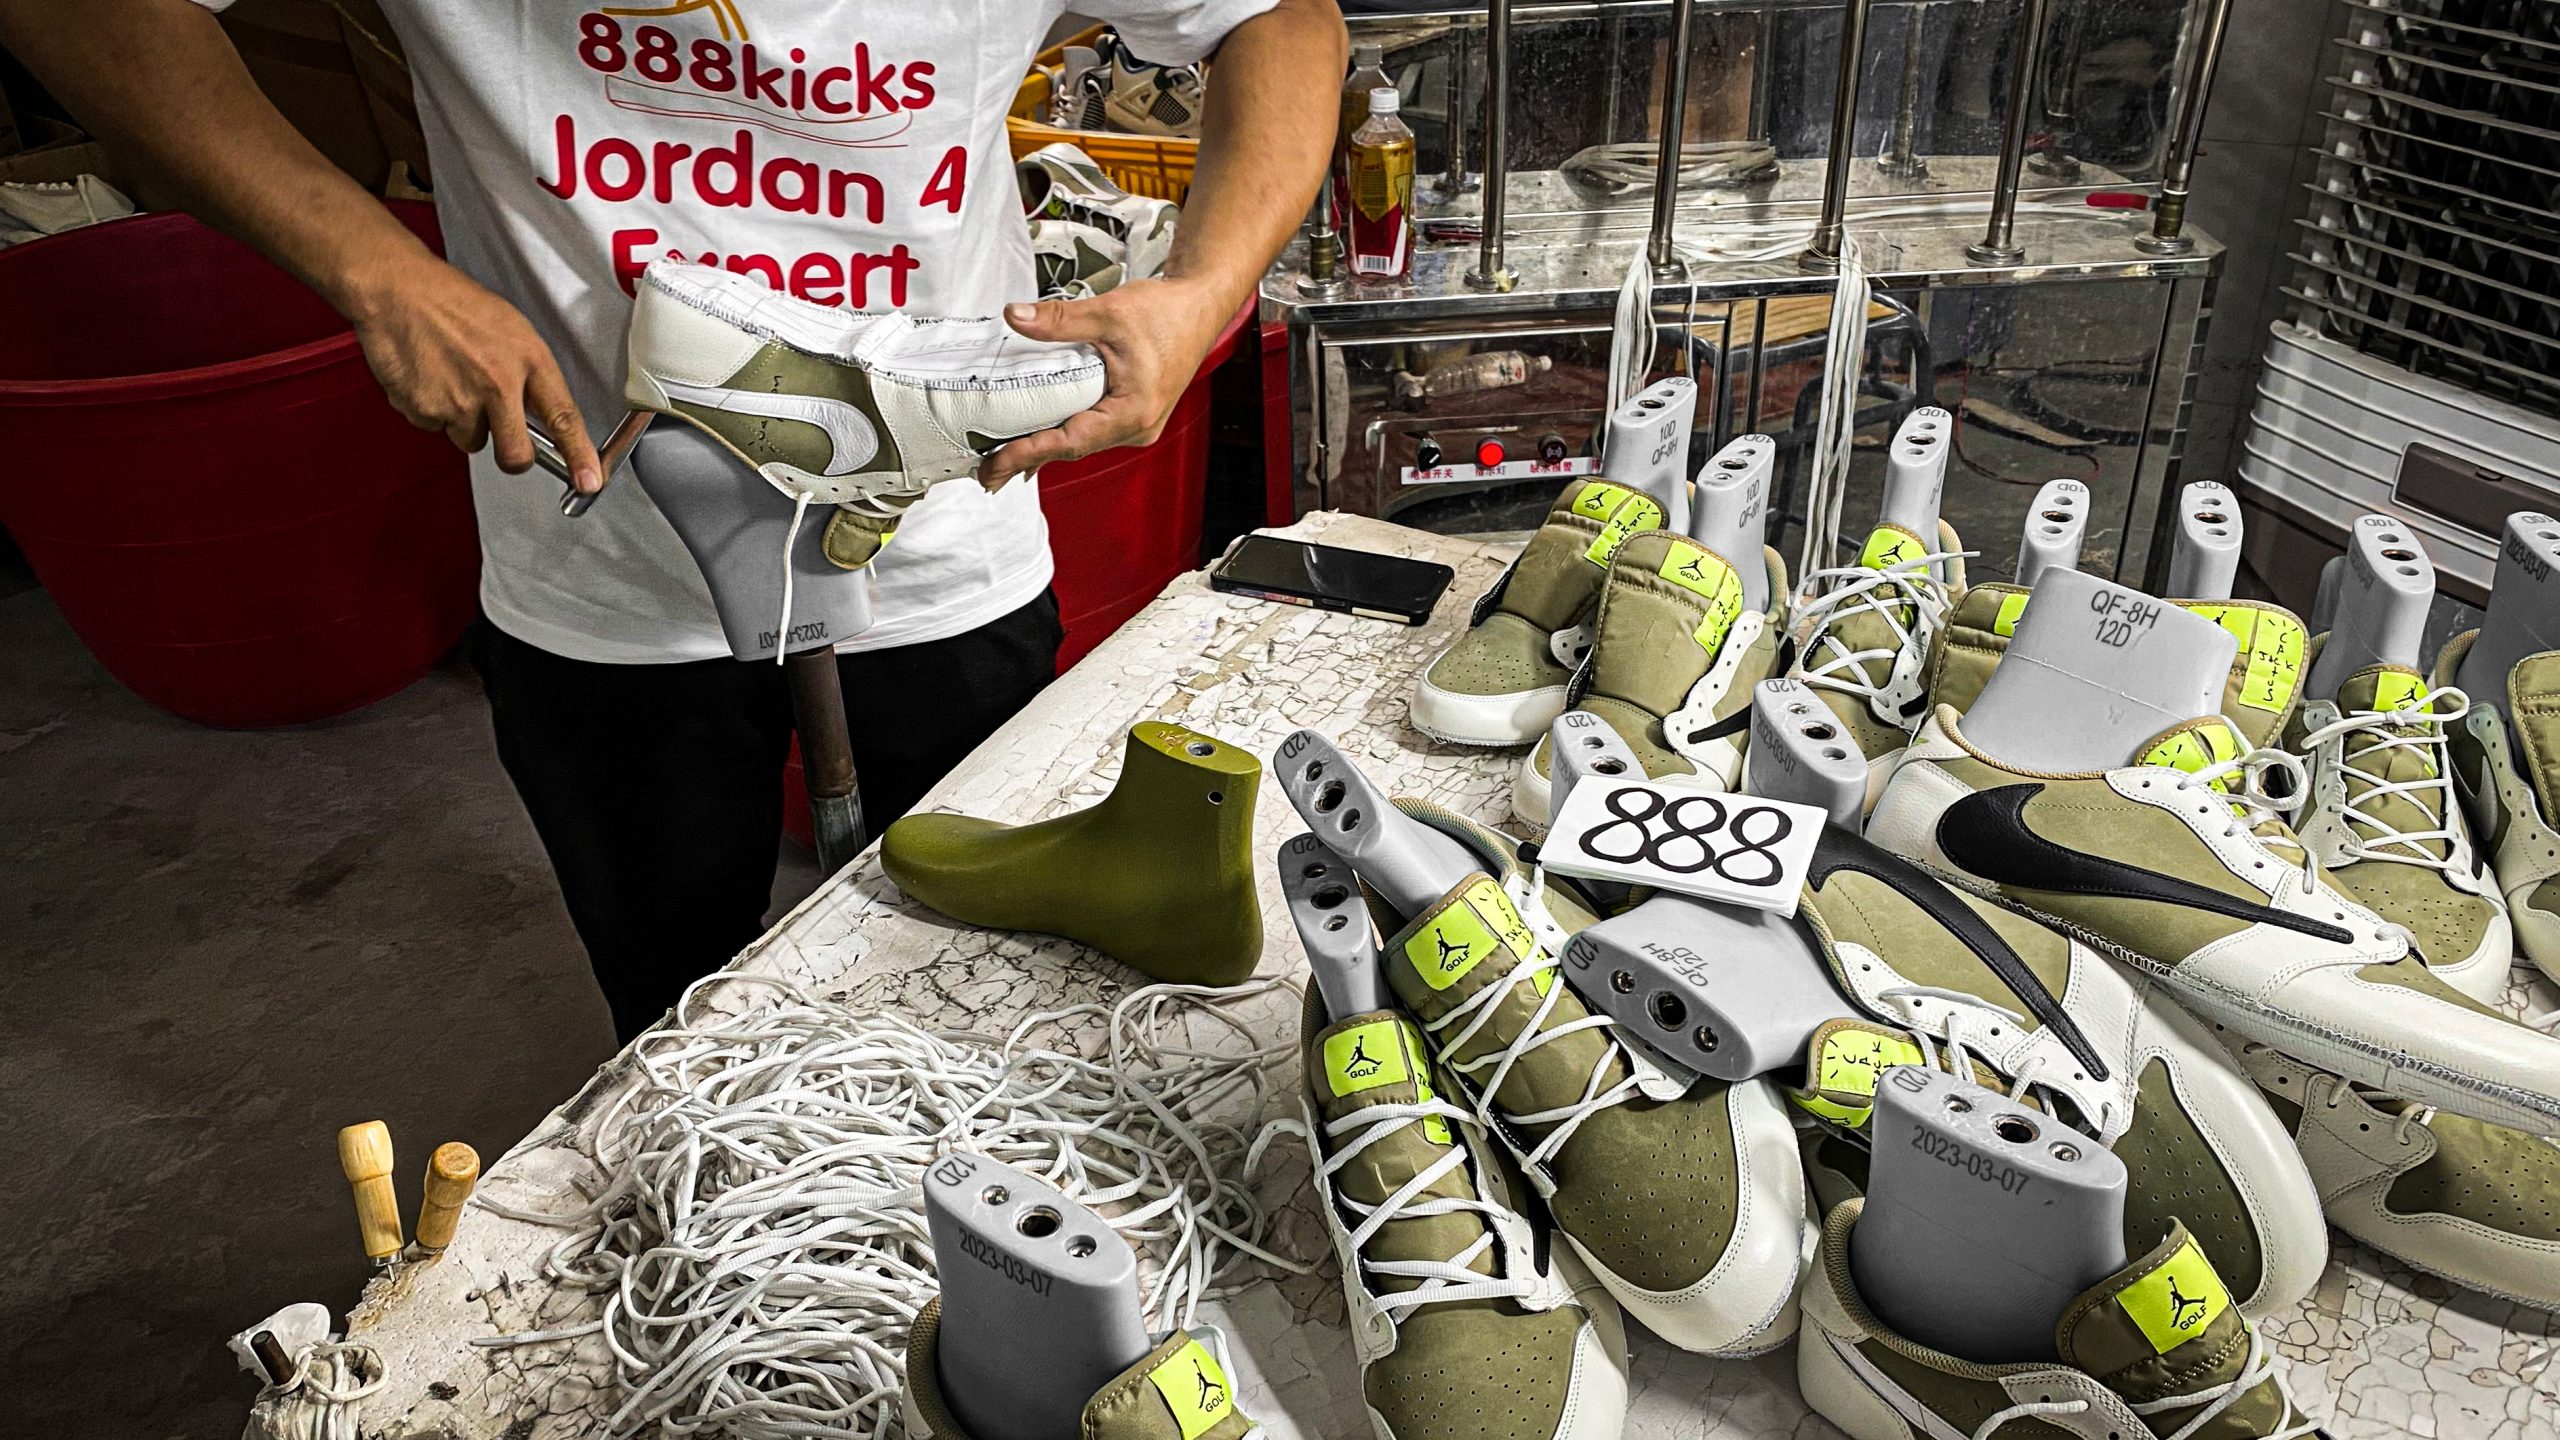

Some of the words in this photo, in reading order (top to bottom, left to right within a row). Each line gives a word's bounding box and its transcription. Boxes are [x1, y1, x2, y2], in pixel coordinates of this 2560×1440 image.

[579, 12, 935, 114] 888kicks
[536, 114, 884, 225] Jordan
[919, 145, 967, 214] 4
[612, 228, 920, 309] Epert
[1918, 407, 1948, 418] 10D
[1660, 420, 1676, 442] 10D
[1651, 437, 1679, 466] QF-8H
[1746, 479, 1760, 503] 10D
[2057, 482, 2086, 493] 10D
[1584, 503, 1600, 511] GOLF
[2522, 514, 2554, 525] 10D
[2364, 518, 2395, 527] 10D
[1680, 570, 1701, 582] GOLF
[2091, 589, 2162, 630] QF-8H
[759, 622, 829, 649] 2023-0-07
[2095, 617, 2132, 648] 12D
[1766, 678, 1798, 694] 12D
[1566, 713, 1598, 729] 12D
[1282, 730, 1312, 759] 12D
[1578, 787, 1793, 887] 888
[1445, 949, 1470, 972] GOLF
[1566, 935, 1601, 971] 12D
[1641, 942, 1709, 987] QF-8H
[1673, 947, 1709, 971] 12D
[1350, 1066, 1379, 1079] GOLF
[1893, 1065, 1933, 1093] 12D
[934, 1155, 978, 1187] 12D
[1910, 1124, 2031, 1196] 2023-03-07
[958, 1227, 1053, 1298] 2023-03-07
[2178, 1305, 2208, 1332] GOLF
[1204, 1389, 1226, 1413] GOLF
